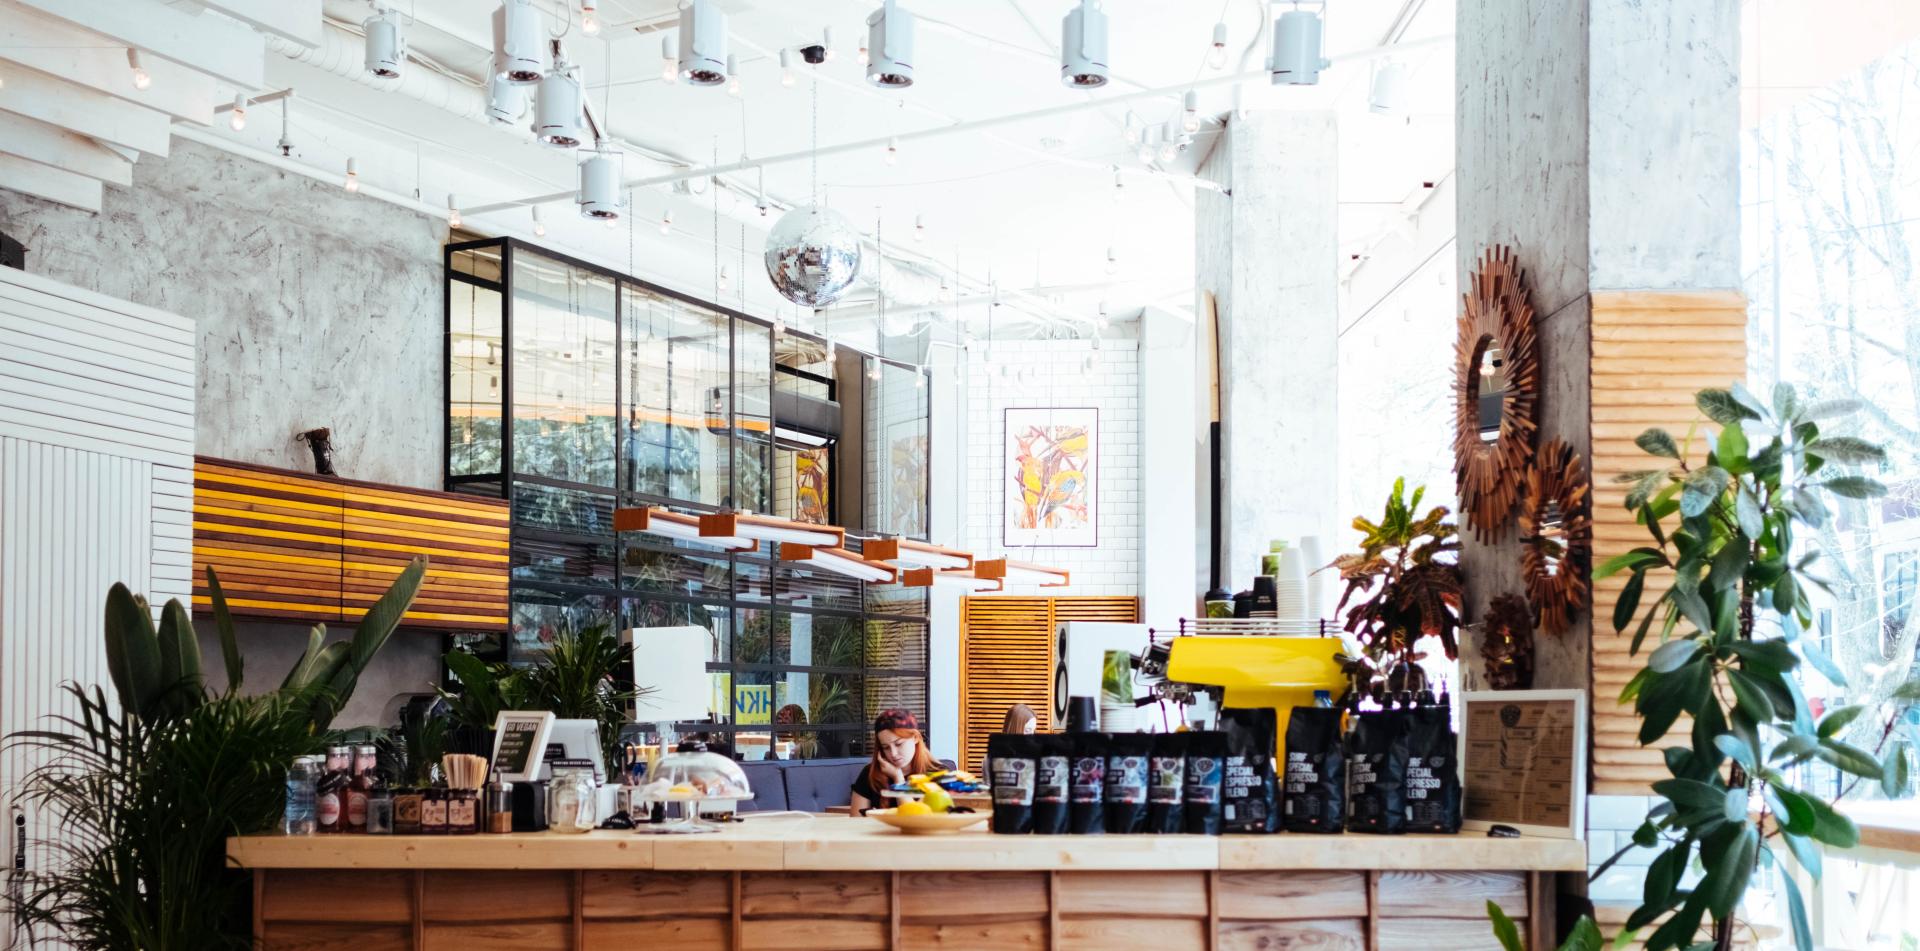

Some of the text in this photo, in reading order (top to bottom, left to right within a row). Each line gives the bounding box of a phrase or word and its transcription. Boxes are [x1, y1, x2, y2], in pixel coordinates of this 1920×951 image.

[506, 722, 538, 732] GO VEGAN
[1226, 757, 1244, 766] SURF
[1408, 758, 1423, 767] URF
[1225, 766, 1253, 777] SPECIAL
[1288, 762, 1313, 772] SPECIAL
[1287, 772, 1318, 783] ESPRESSO
[1407, 768, 1432, 778] PECIAL
[1225, 776, 1262, 787] ESPRESSO
[1406, 778, 1441, 789] SPRESSO
[1407, 789, 1427, 799] LEND
